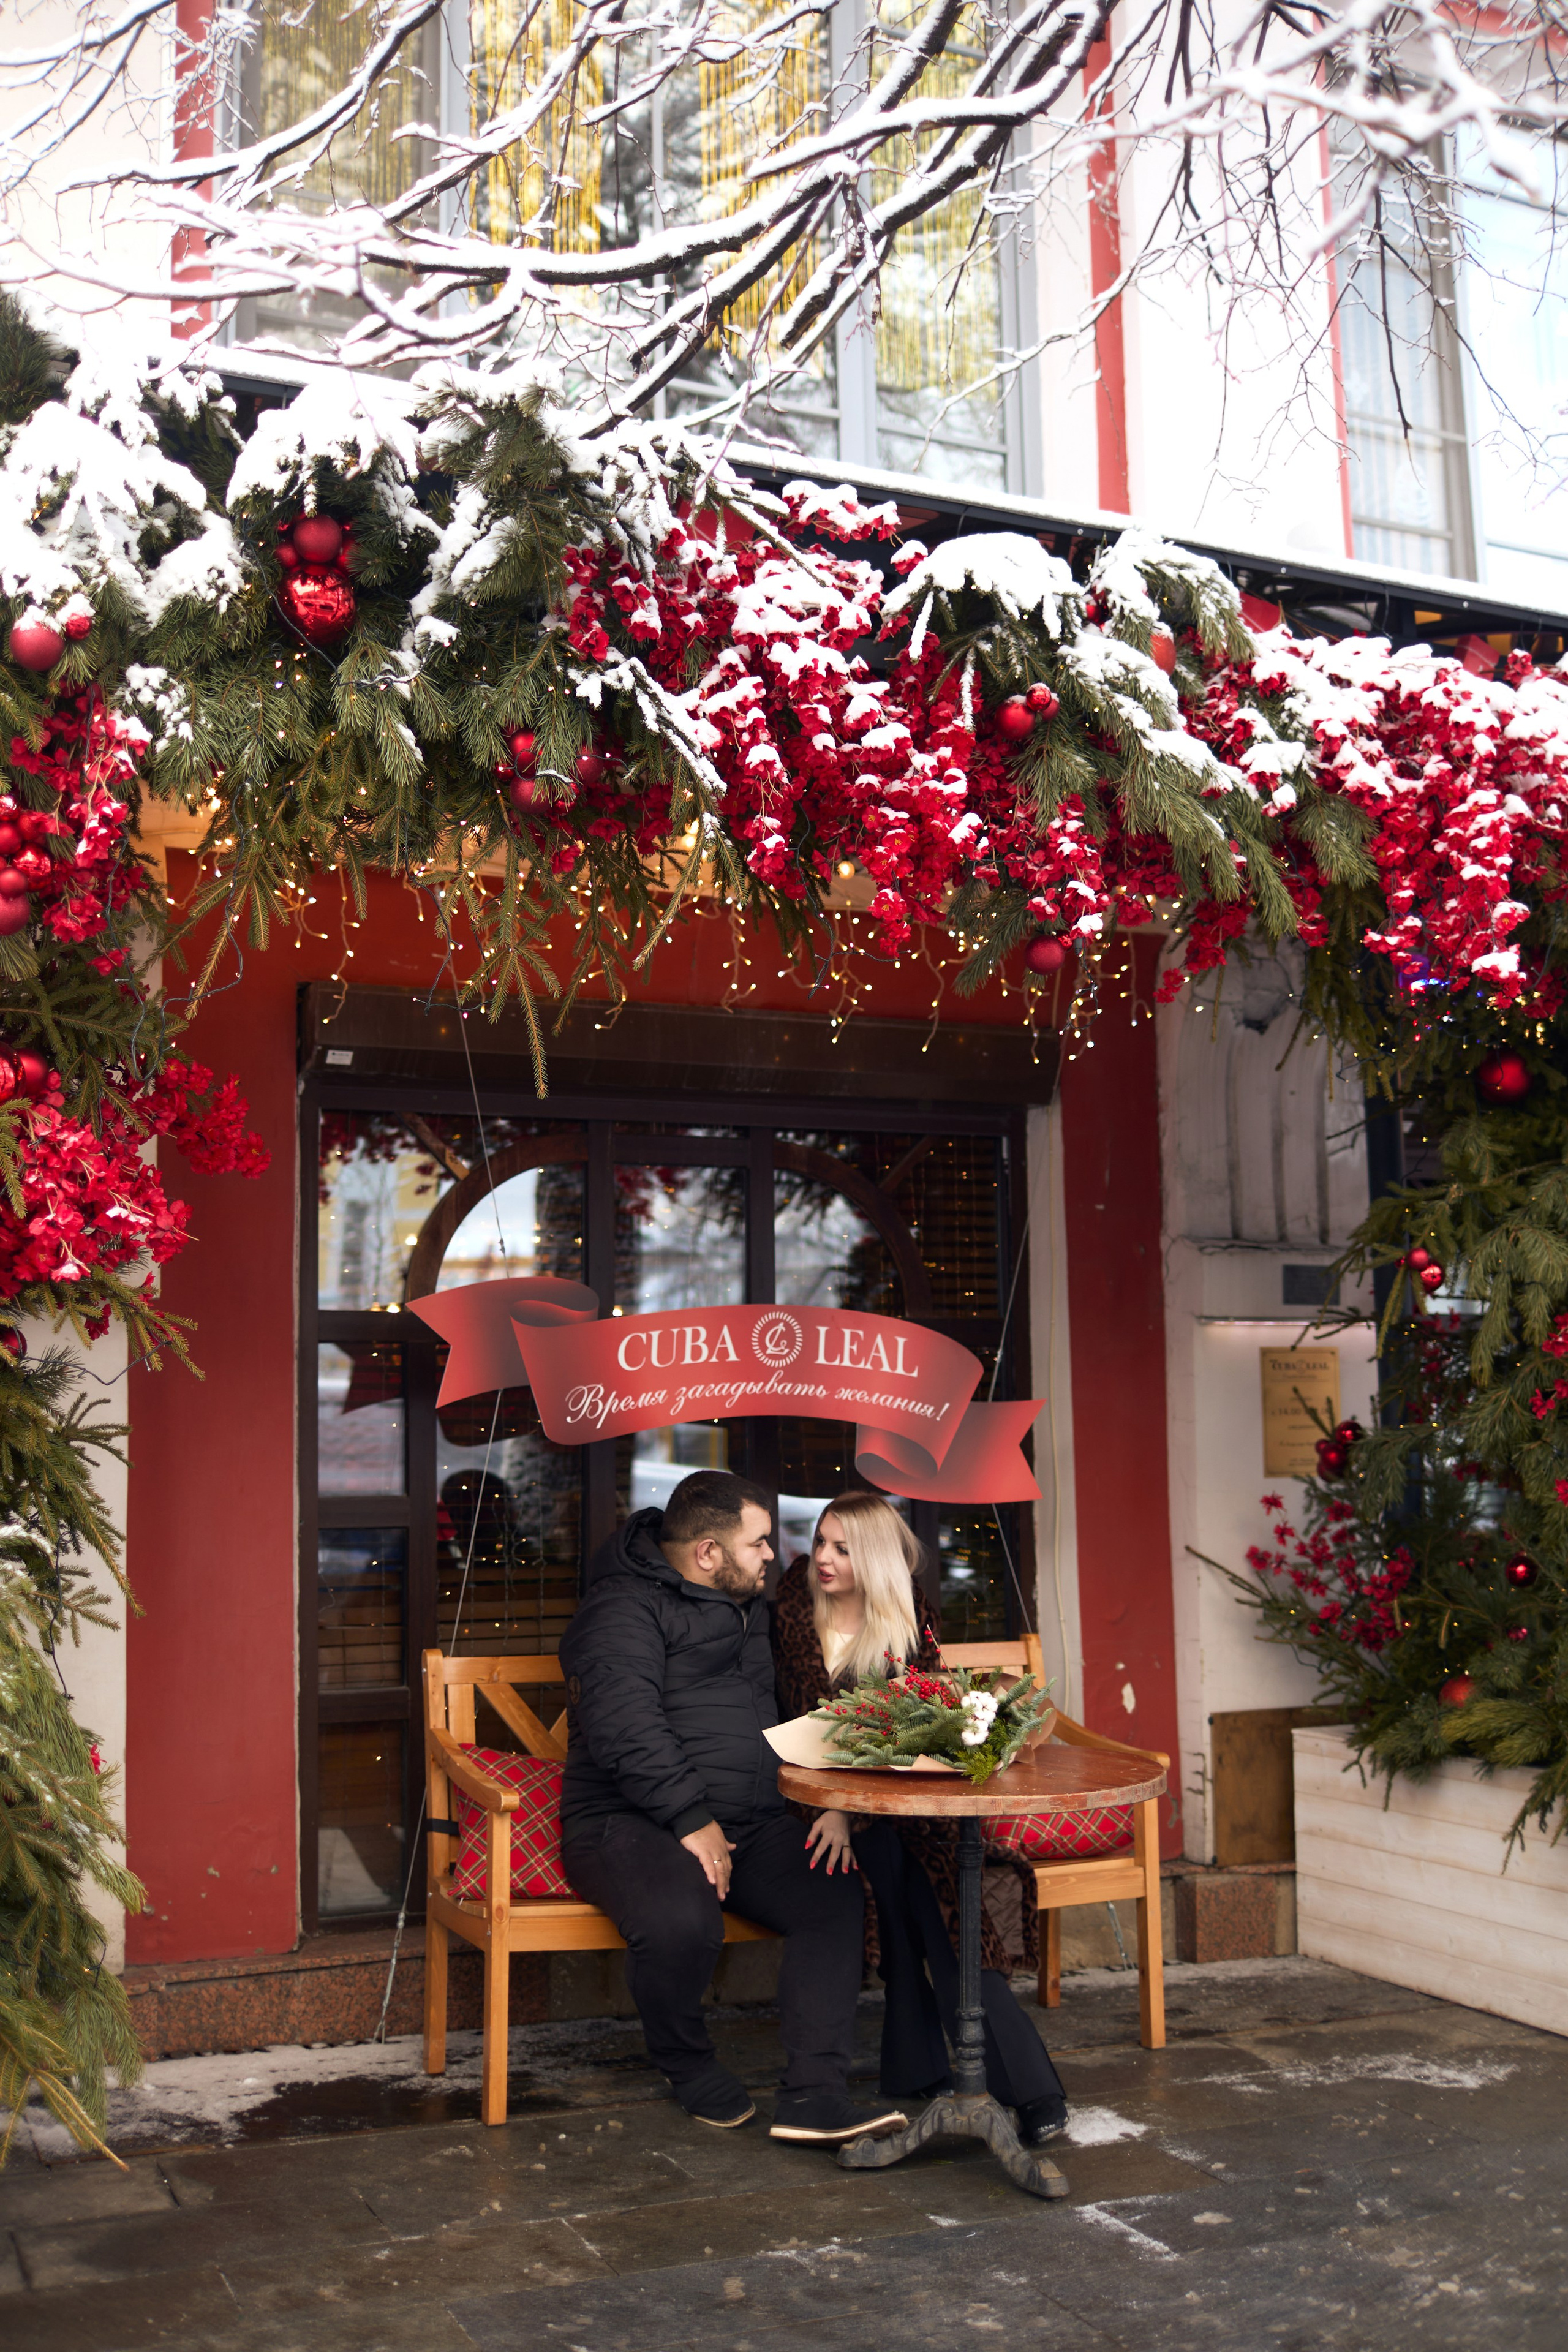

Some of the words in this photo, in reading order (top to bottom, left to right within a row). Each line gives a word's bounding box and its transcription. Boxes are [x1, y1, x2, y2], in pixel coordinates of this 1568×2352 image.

[617, 1324, 741, 1371] CUBA
[813, 1325, 919, 1378] LEAL
[565, 1382, 669, 1430] Время
[669, 1369, 830, 1416] загадывать
[835, 1387, 950, 1422] желания!
